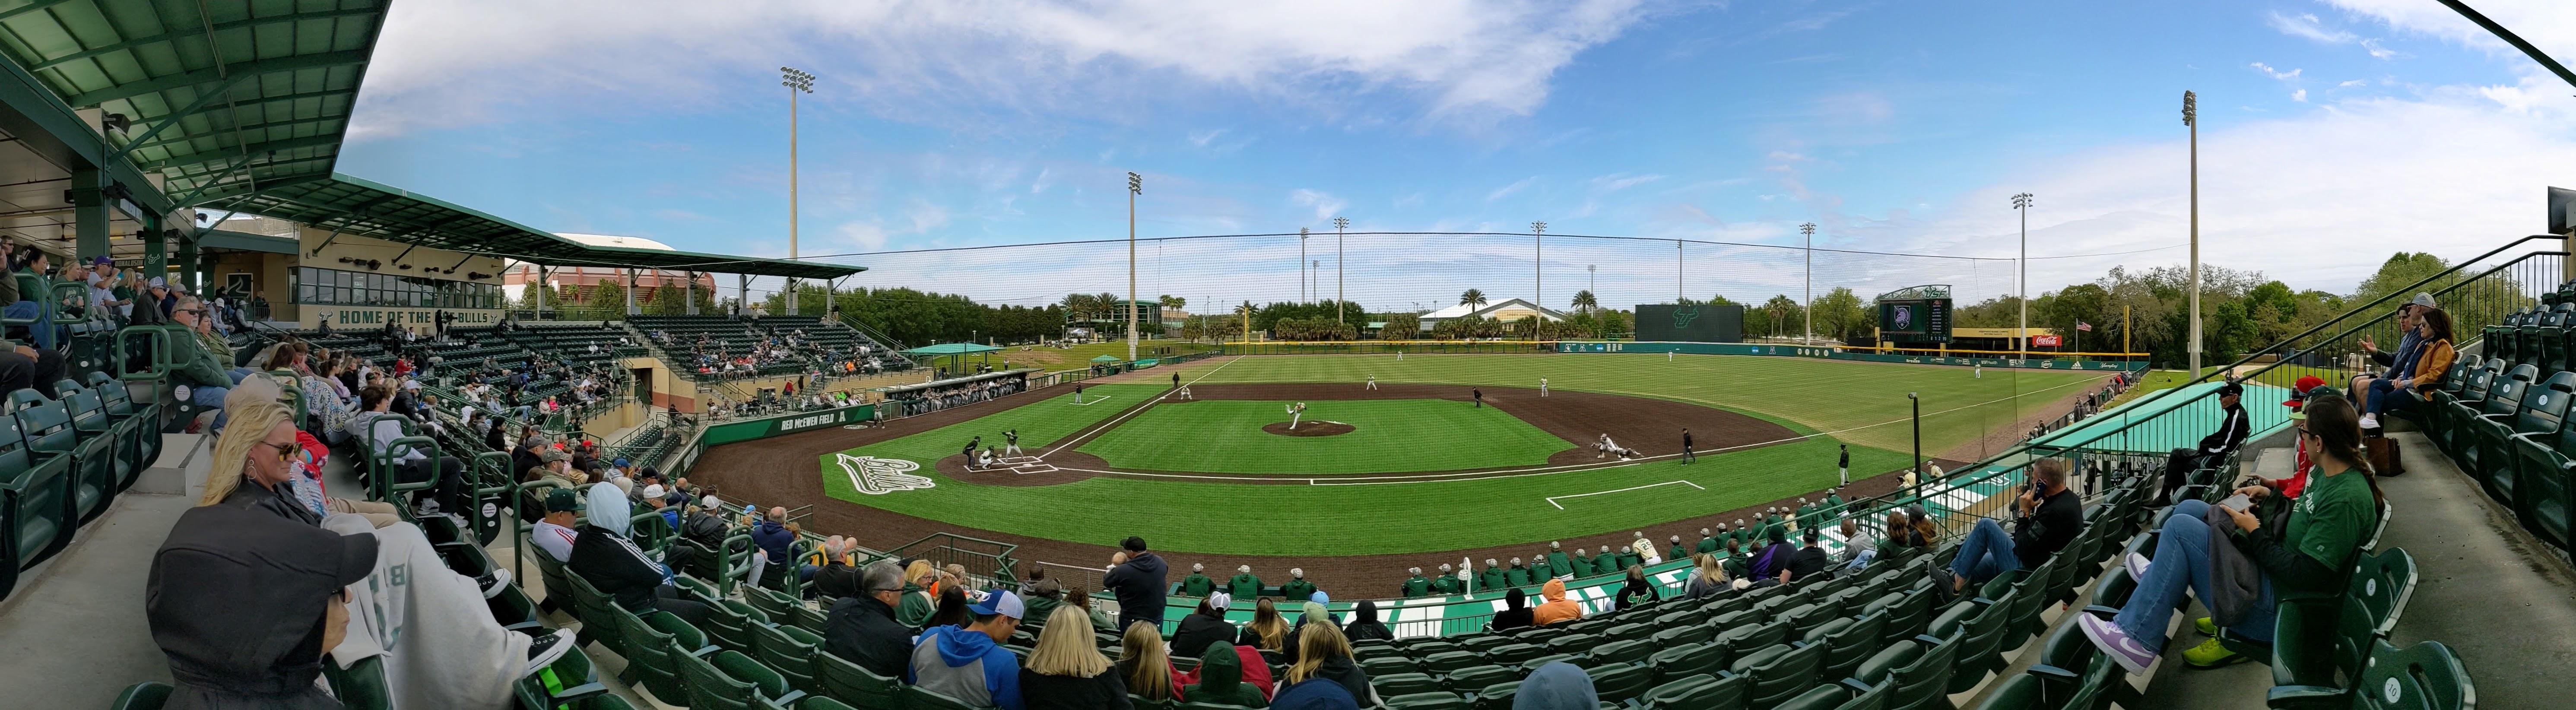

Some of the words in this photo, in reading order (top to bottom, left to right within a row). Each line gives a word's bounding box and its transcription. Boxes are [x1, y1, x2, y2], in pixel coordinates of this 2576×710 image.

[1925, 286, 1948, 299] USF
[340, 311, 382, 324] HOME
[387, 311, 403, 323] OF
[408, 312, 431, 323] THE
[458, 313, 487, 323] BULLS
[2037, 336, 2057, 344] Coca-Cola
[781, 419, 793, 431] RED
[794, 416, 818, 429] McEWEN
[819, 414, 834, 424] FIELD
[2389, 684, 2397, 697] 10
